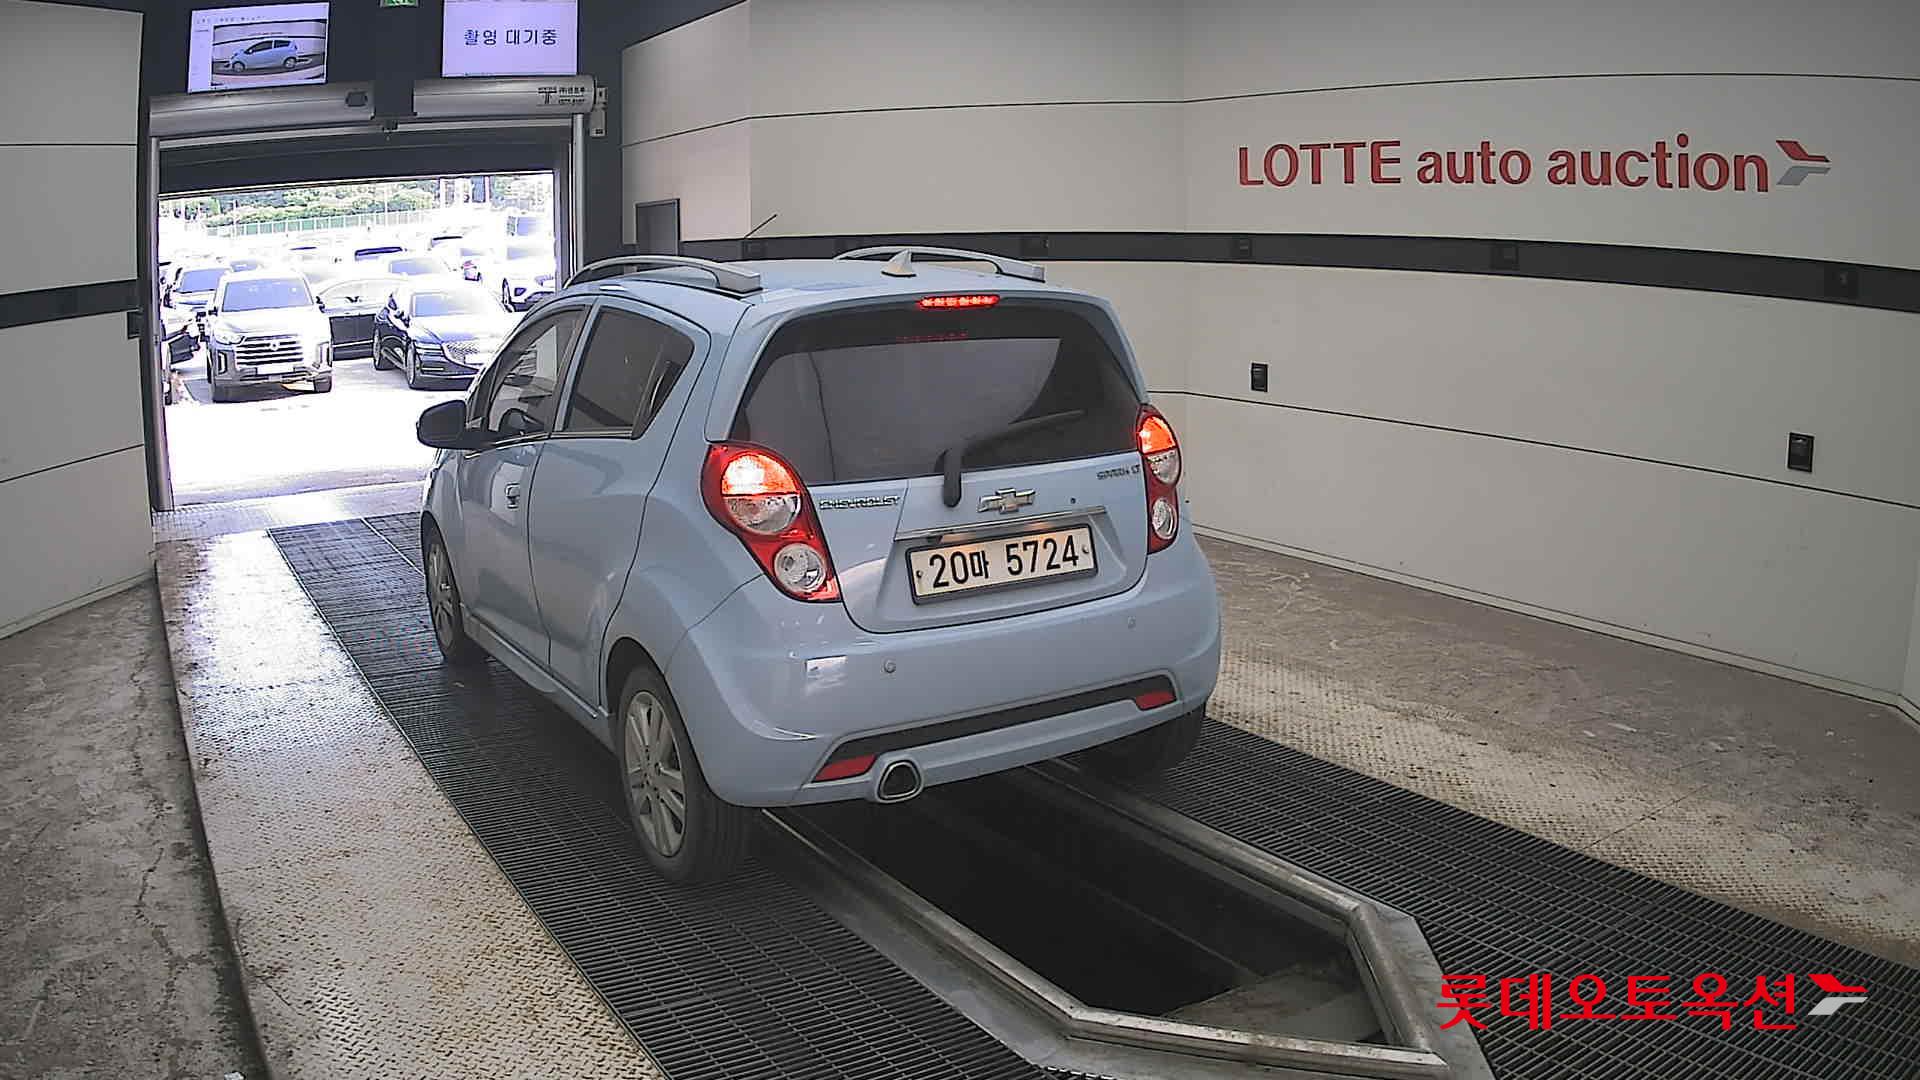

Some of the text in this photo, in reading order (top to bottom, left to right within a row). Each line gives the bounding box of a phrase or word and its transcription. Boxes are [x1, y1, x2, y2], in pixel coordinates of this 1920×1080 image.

[464, 28, 558, 46] 촬영 대기중
[1238, 133, 1769, 192] LOTTE auto auction
[929, 535, 1079, 588] 20마 5724
